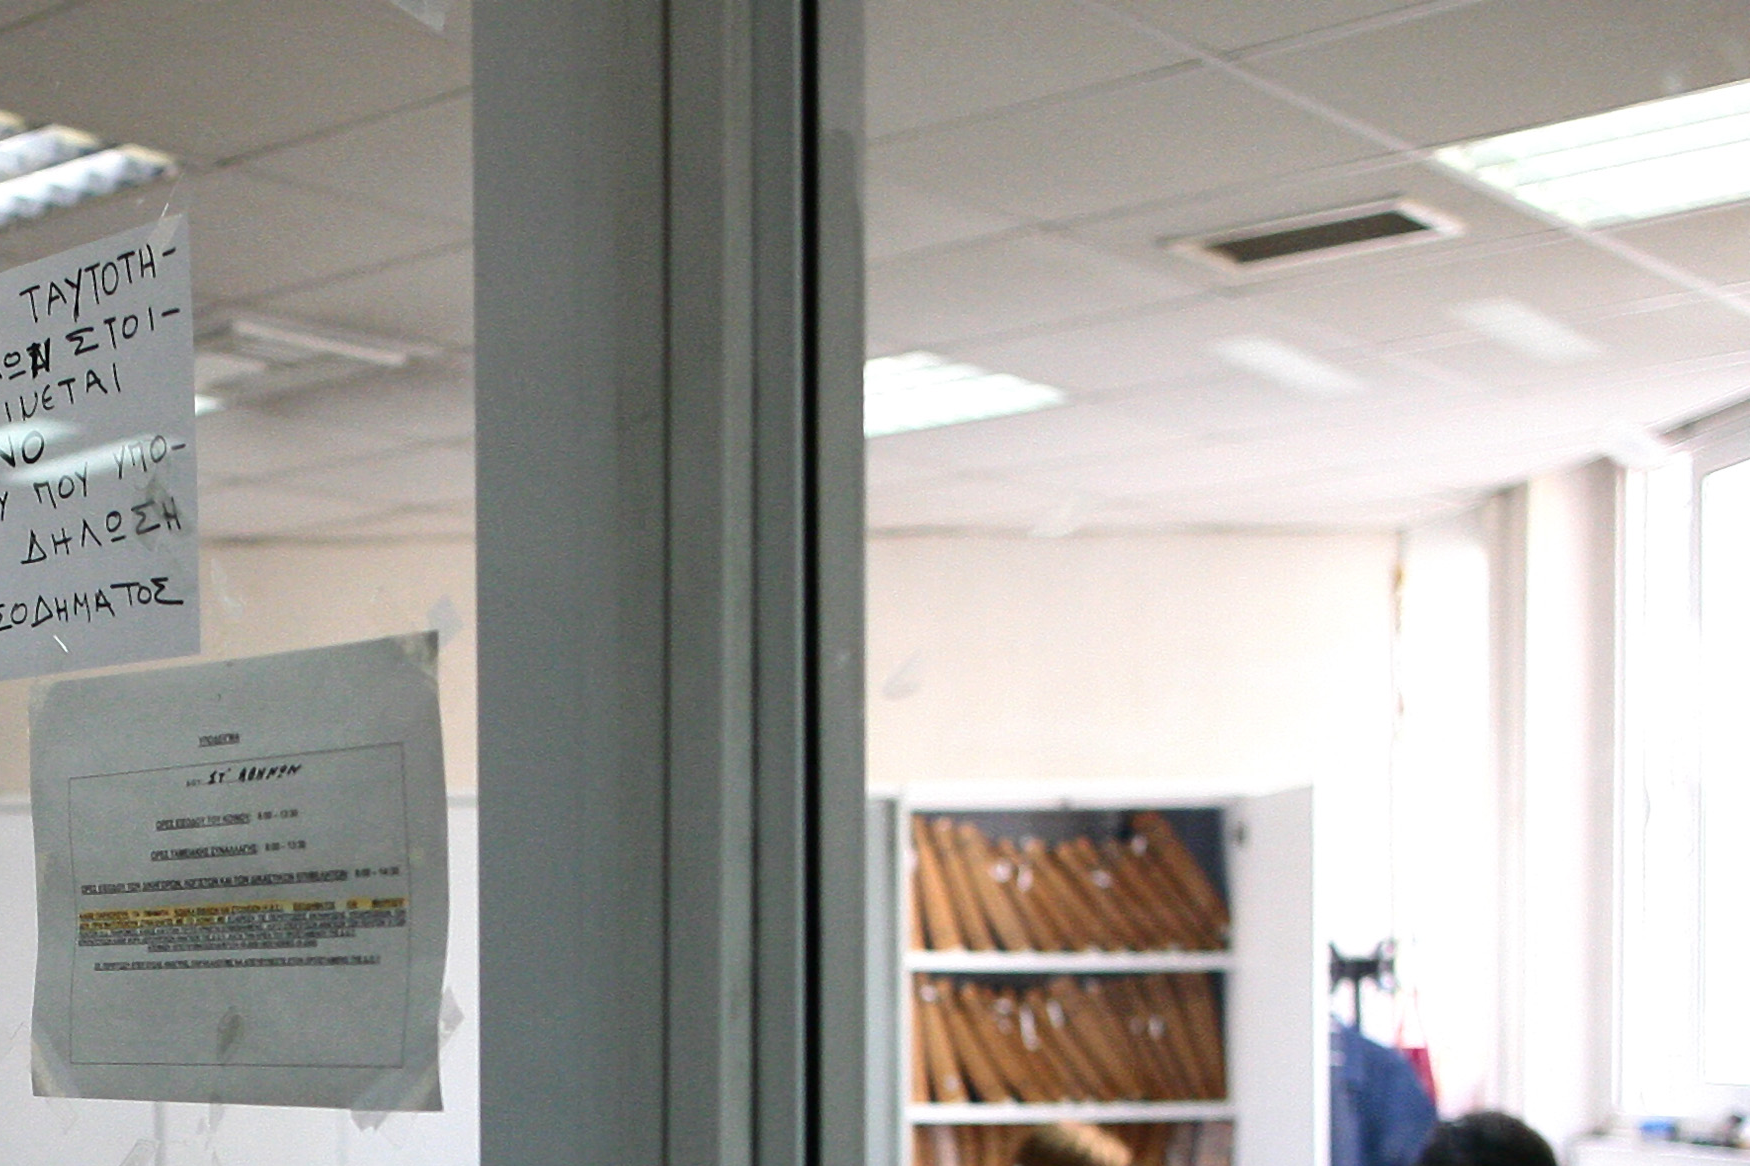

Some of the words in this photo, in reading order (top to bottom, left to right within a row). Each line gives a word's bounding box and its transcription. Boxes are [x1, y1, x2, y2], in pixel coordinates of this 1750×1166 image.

[19, 244, 176, 322] ΤΑΥΤΟΤΗ-
[33, 462, 89, 509] ΠΟΥ
[21, 497, 182, 565] ΔΗΛΩΣΗ
